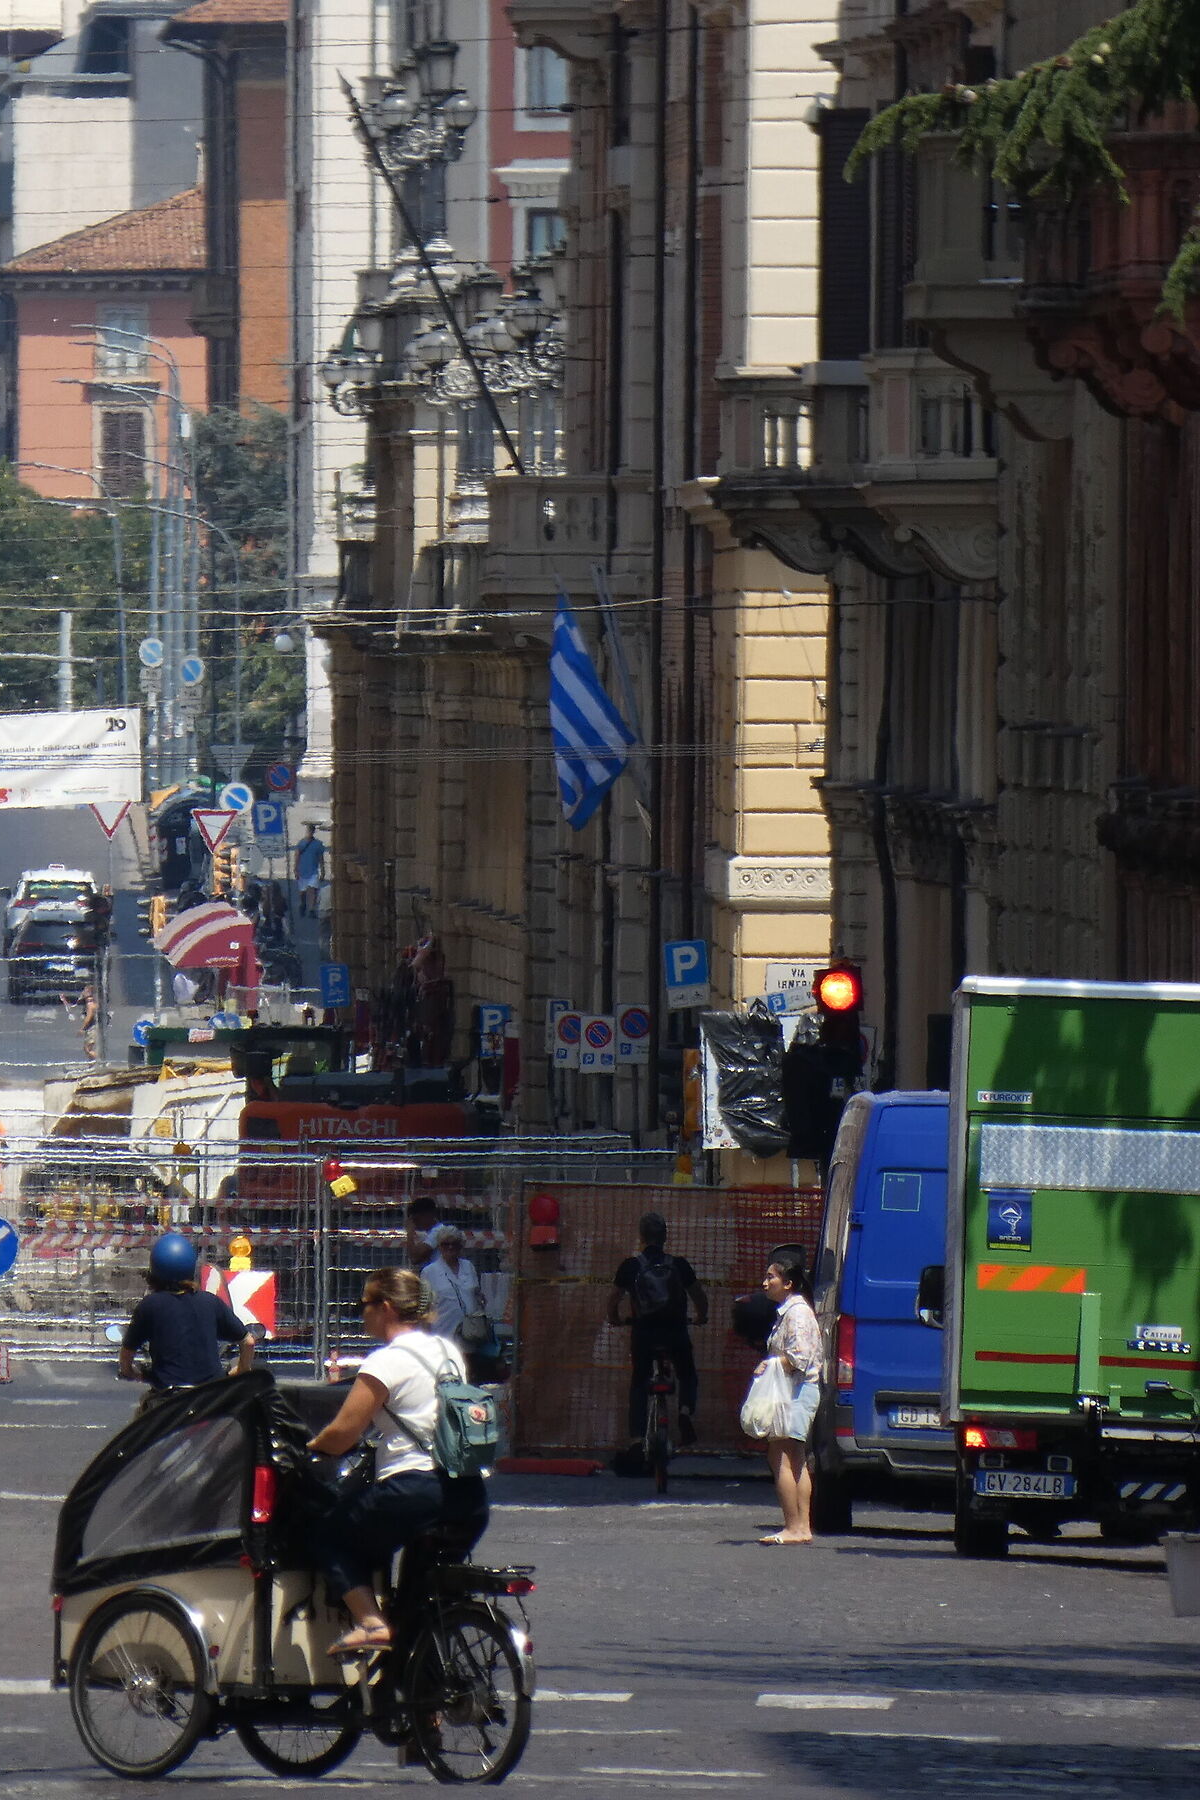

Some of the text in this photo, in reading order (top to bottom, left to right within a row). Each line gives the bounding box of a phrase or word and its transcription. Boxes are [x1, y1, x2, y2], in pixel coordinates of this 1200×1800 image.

[672, 946, 698, 982] P
[792, 969, 806, 978] VIA
[990, 1093, 1030, 1102] FURGOKIT
[300, 1119, 398, 1135] HITACHI
[900, 1407, 917, 1423] GD
[1013, 1475, 1063, 1494] 284LB
